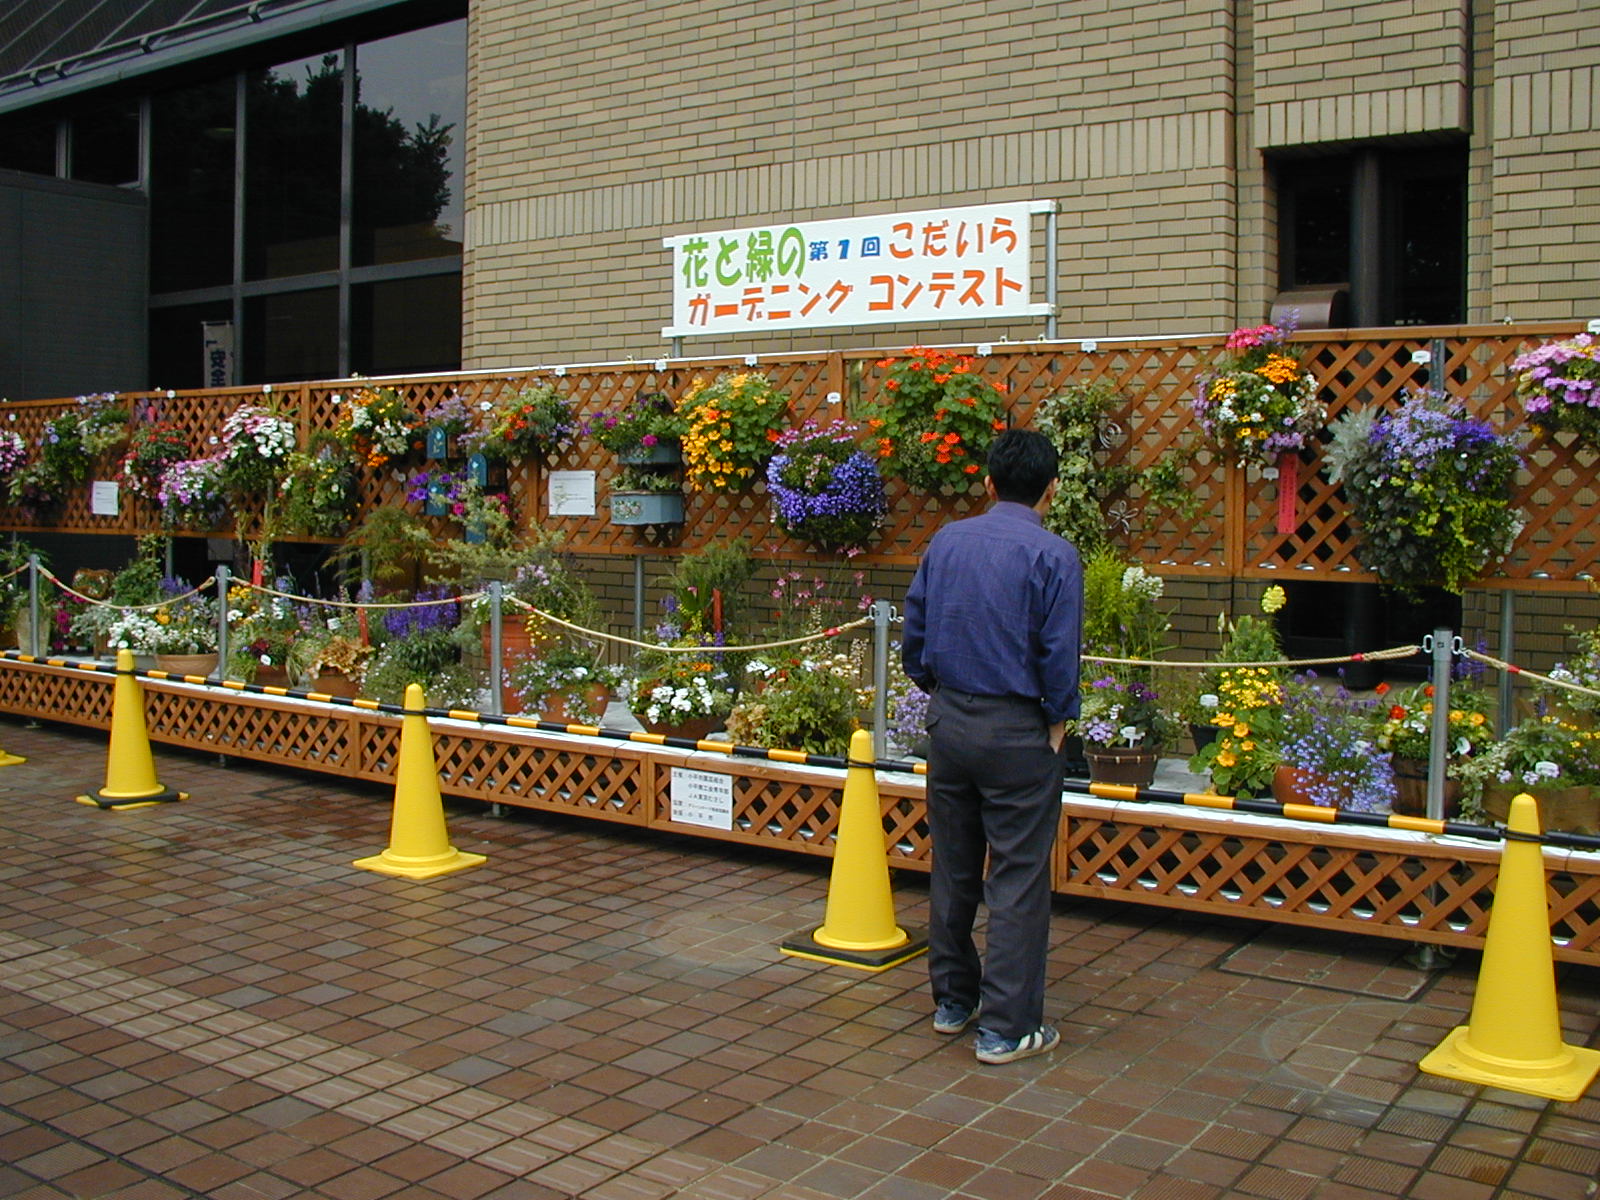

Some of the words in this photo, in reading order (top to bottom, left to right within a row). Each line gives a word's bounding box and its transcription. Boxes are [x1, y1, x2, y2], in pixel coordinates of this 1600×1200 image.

[682, 227, 805, 289] 花と緑の
[889, 217, 1017, 259] こだいら
[688, 279, 853, 326] ガーデニング
[868, 267, 1023, 312] コンテスト
